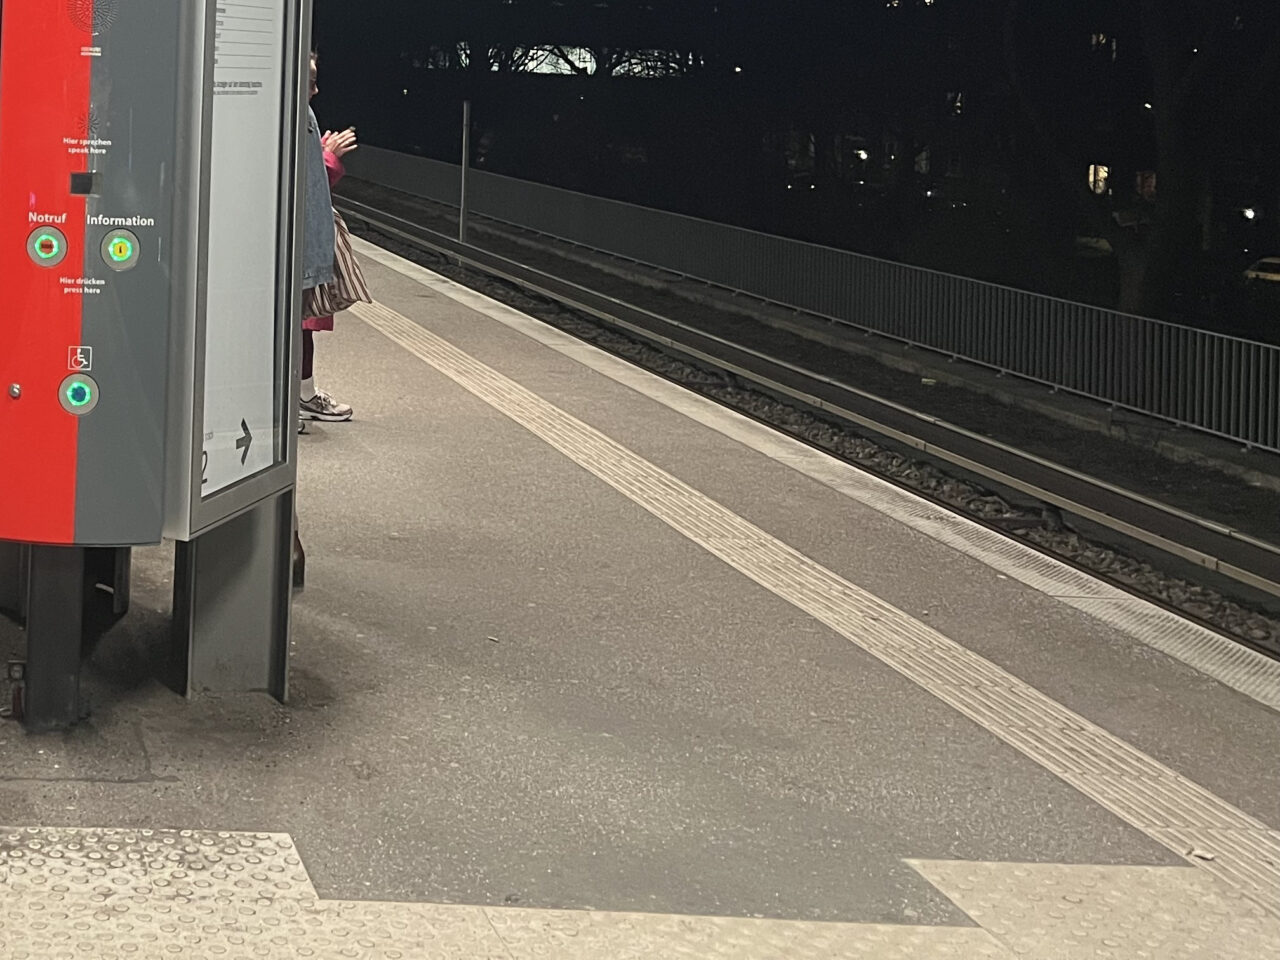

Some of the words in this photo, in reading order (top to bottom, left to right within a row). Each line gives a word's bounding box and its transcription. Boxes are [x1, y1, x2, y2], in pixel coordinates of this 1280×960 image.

[63, 137, 78, 145] Hier
[80, 137, 112, 148] sprechen
[68, 146, 89, 155] speak
[90, 146, 107, 155] here
[28, 212, 67, 224] Notruf
[86, 214, 155, 227] Information
[59, 277, 75, 285] Hier
[76, 277, 105, 286] drücken
[64, 286, 83, 295] press
[84, 286, 101, 295] here
